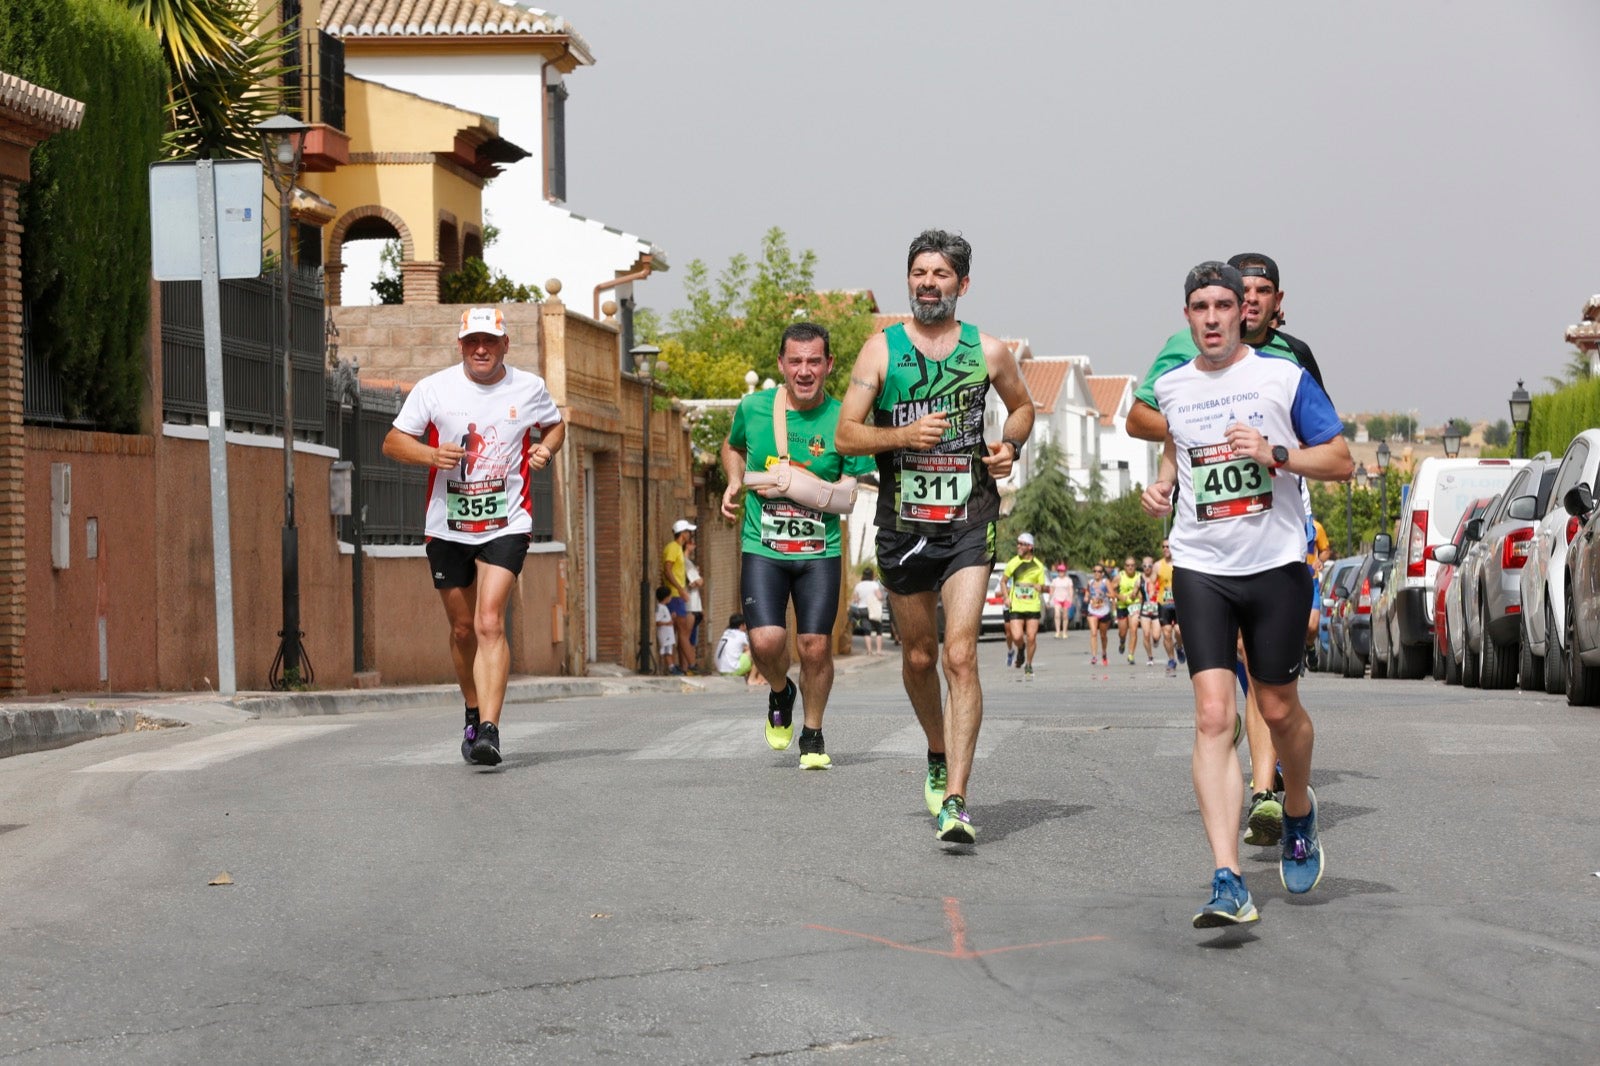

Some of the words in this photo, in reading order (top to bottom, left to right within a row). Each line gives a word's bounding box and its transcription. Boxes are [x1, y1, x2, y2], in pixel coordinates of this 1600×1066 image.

[892, 401, 928, 427] TEAM
[1178, 405, 1190, 414] XVII
[1192, 399, 1220, 411] PRUEBA
[1221, 396, 1230, 405] DE
[1232, 391, 1259, 403] FONDO
[913, 475, 958, 500] 311
[1204, 462, 1262, 496] 403
[457, 496, 498, 517] 355
[773, 519, 816, 538] 763
[717, 638, 729, 659] 7
